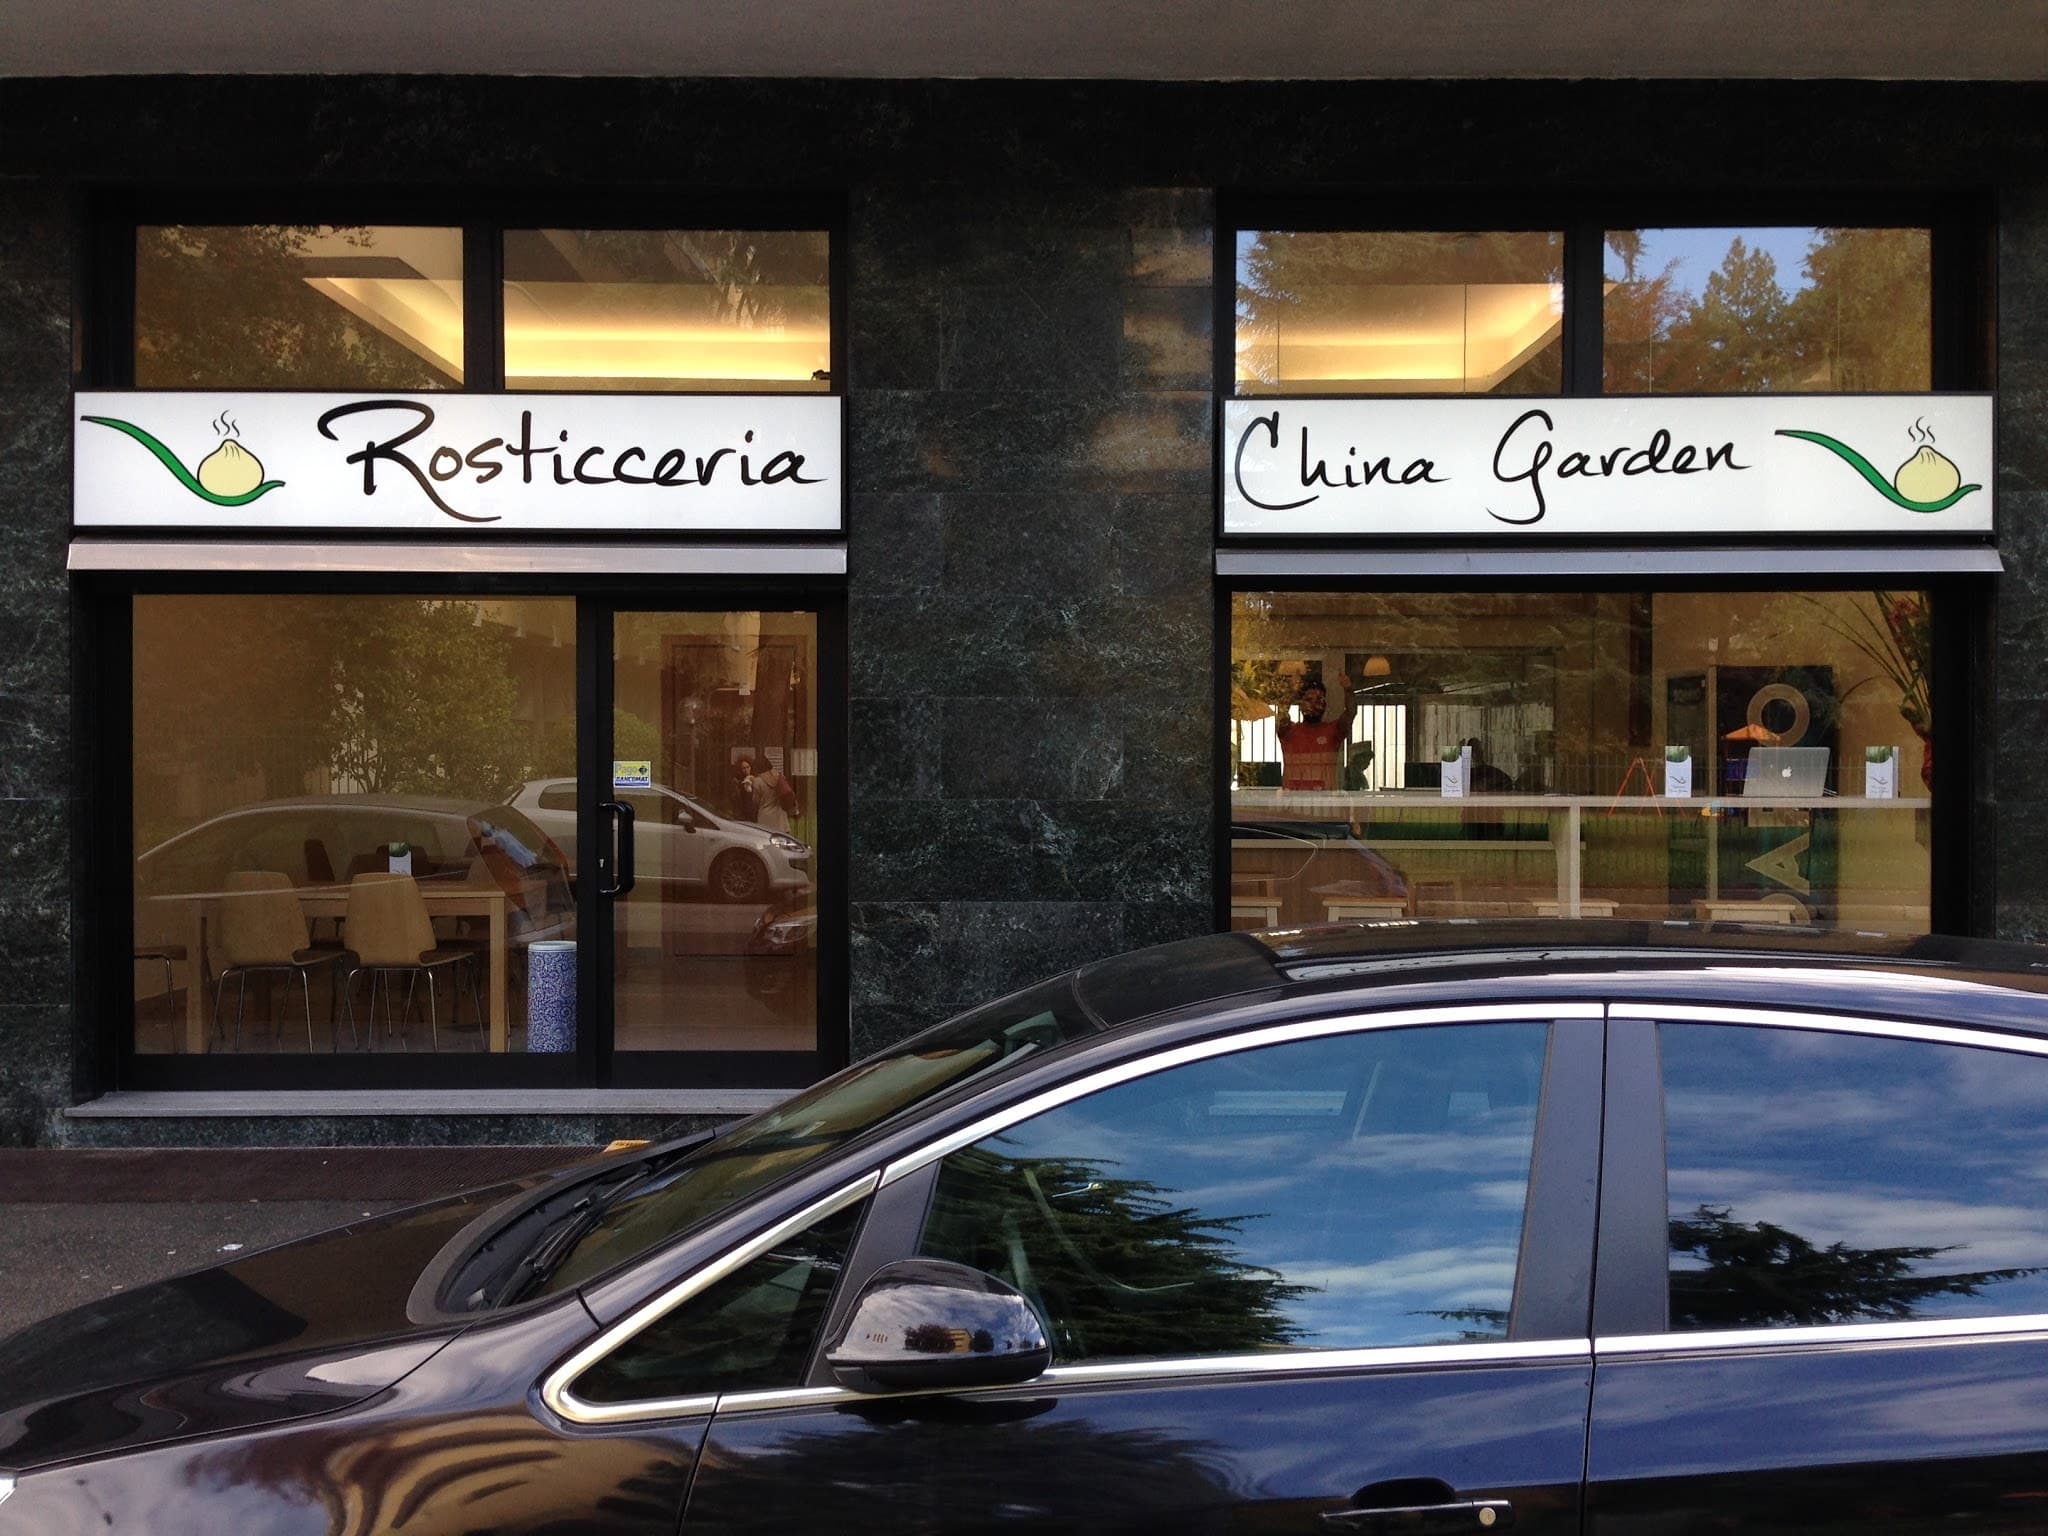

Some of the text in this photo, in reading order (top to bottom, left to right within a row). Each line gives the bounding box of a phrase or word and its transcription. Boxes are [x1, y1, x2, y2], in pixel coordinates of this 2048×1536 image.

[317, 399, 827, 523] Rosticceria
[1234, 408, 1752, 525] China Garden
